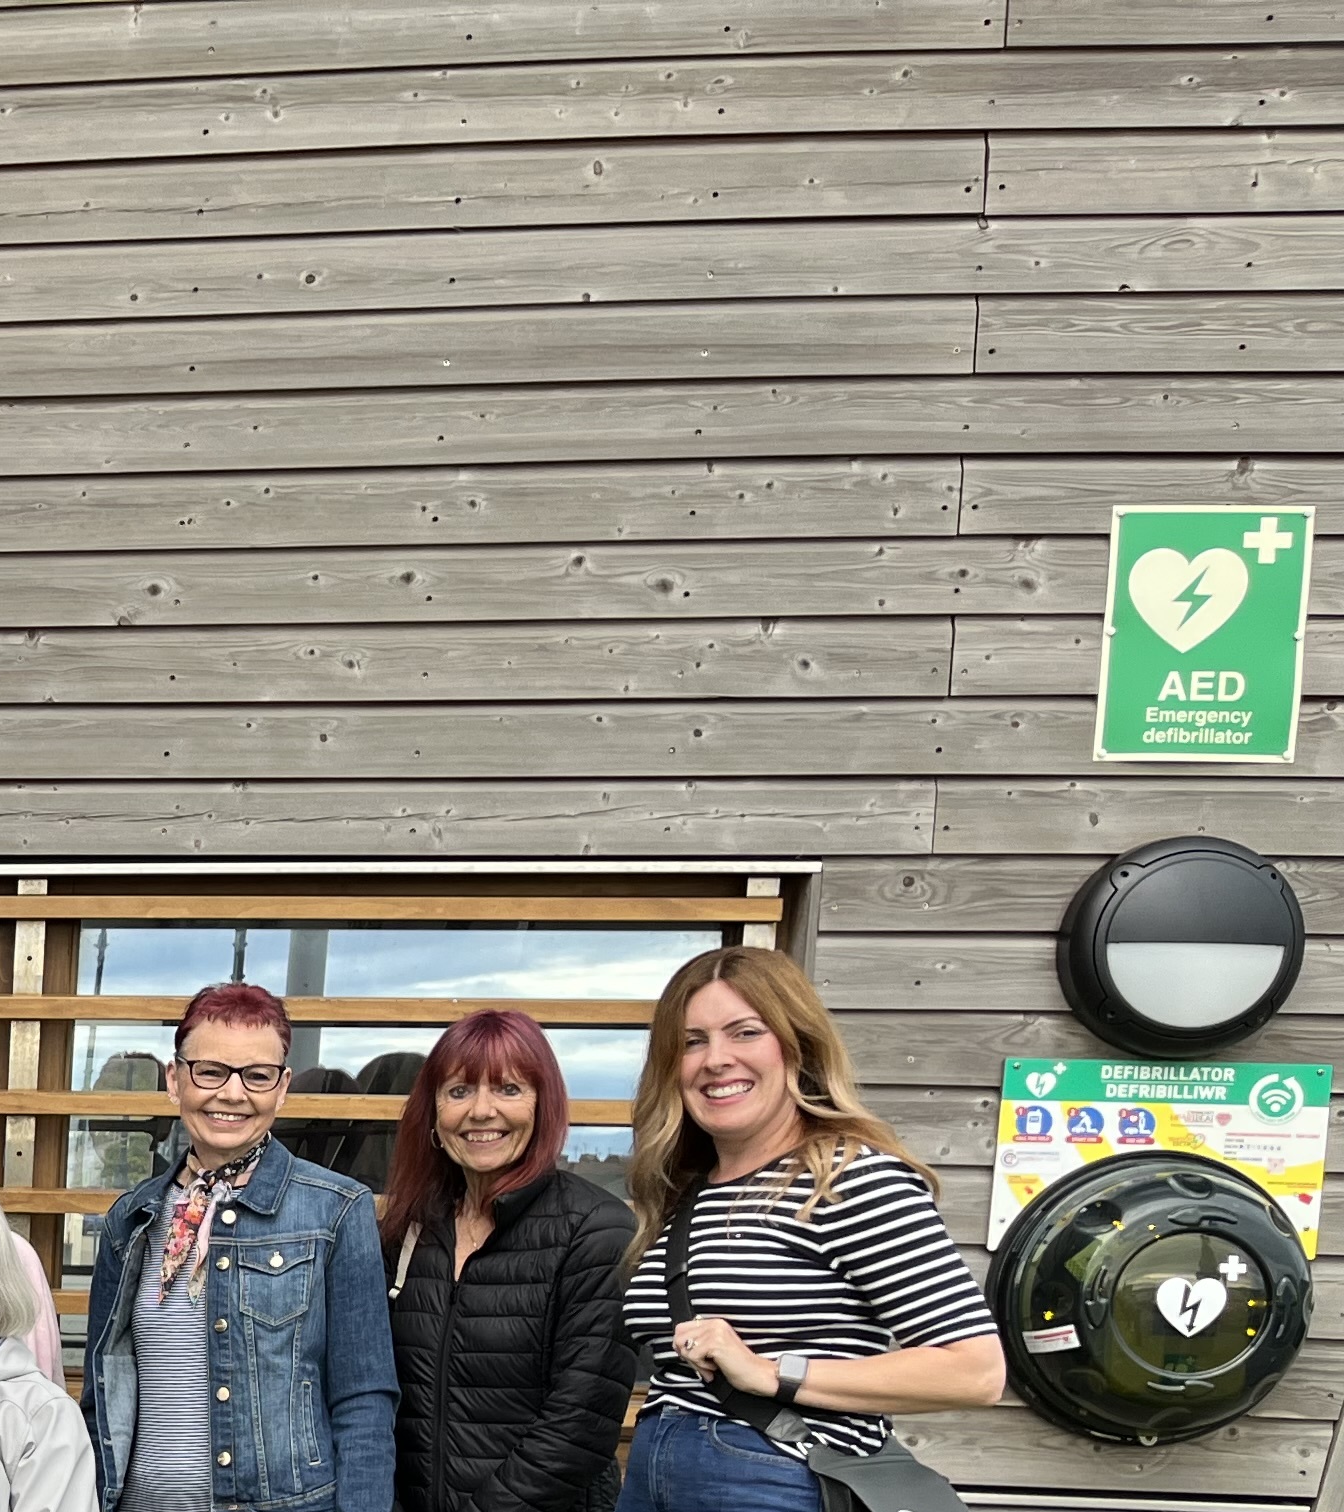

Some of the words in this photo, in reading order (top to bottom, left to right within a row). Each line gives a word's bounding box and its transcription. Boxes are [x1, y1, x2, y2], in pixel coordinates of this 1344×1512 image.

[1157, 670, 1246, 703] AED
[1145, 706, 1253, 728] Emergency
[1142, 727, 1253, 745] defibrillator
[1100, 1064, 1236, 1082] DEFIBRILLATOR
[1105, 1083, 1228, 1101] DEFRIBILLIWR
